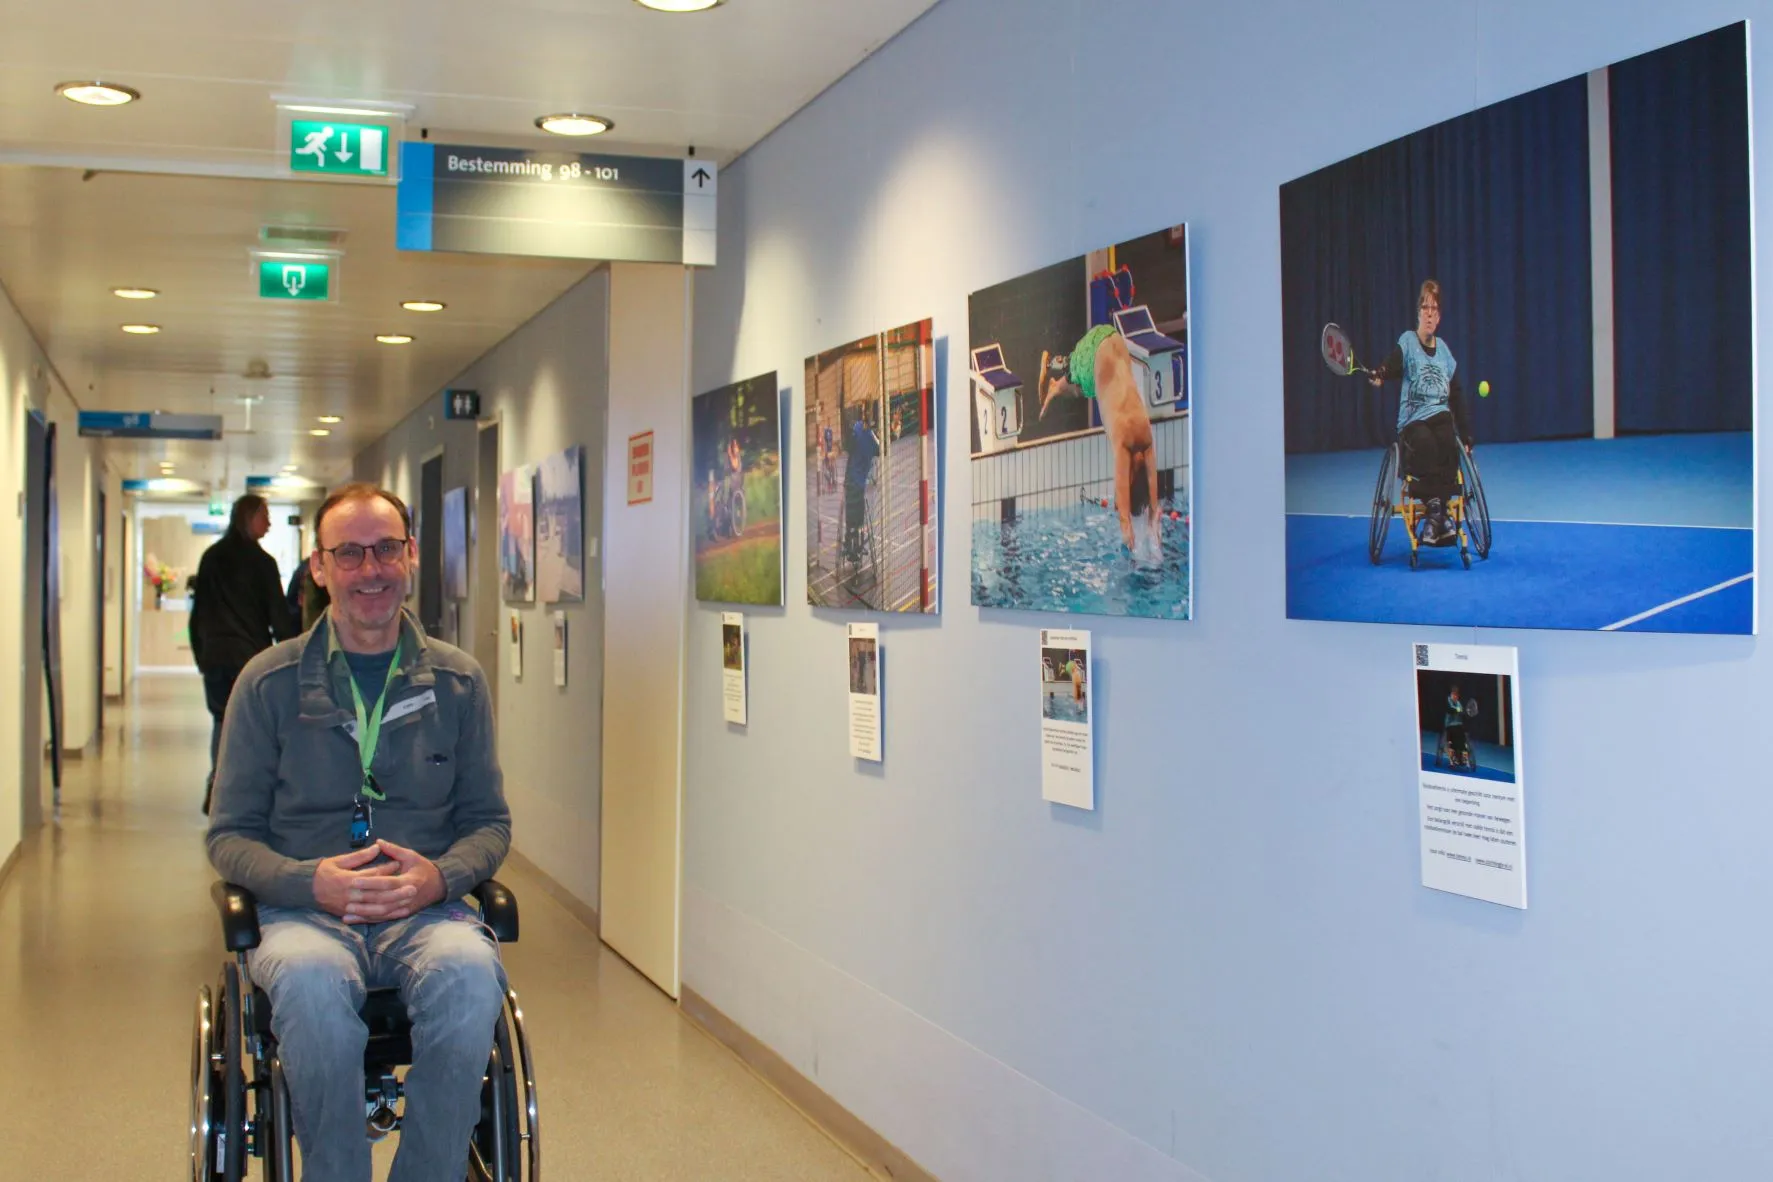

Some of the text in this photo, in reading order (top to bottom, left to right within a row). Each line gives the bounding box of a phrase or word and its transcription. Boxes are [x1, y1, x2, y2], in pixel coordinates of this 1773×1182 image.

[447, 155, 553, 181] Bestemming
[559, 162, 582, 180] 98
[594, 167, 619, 180] 101
[1154, 370, 1162, 400] 3
[1001, 406, 1008, 434] 2
